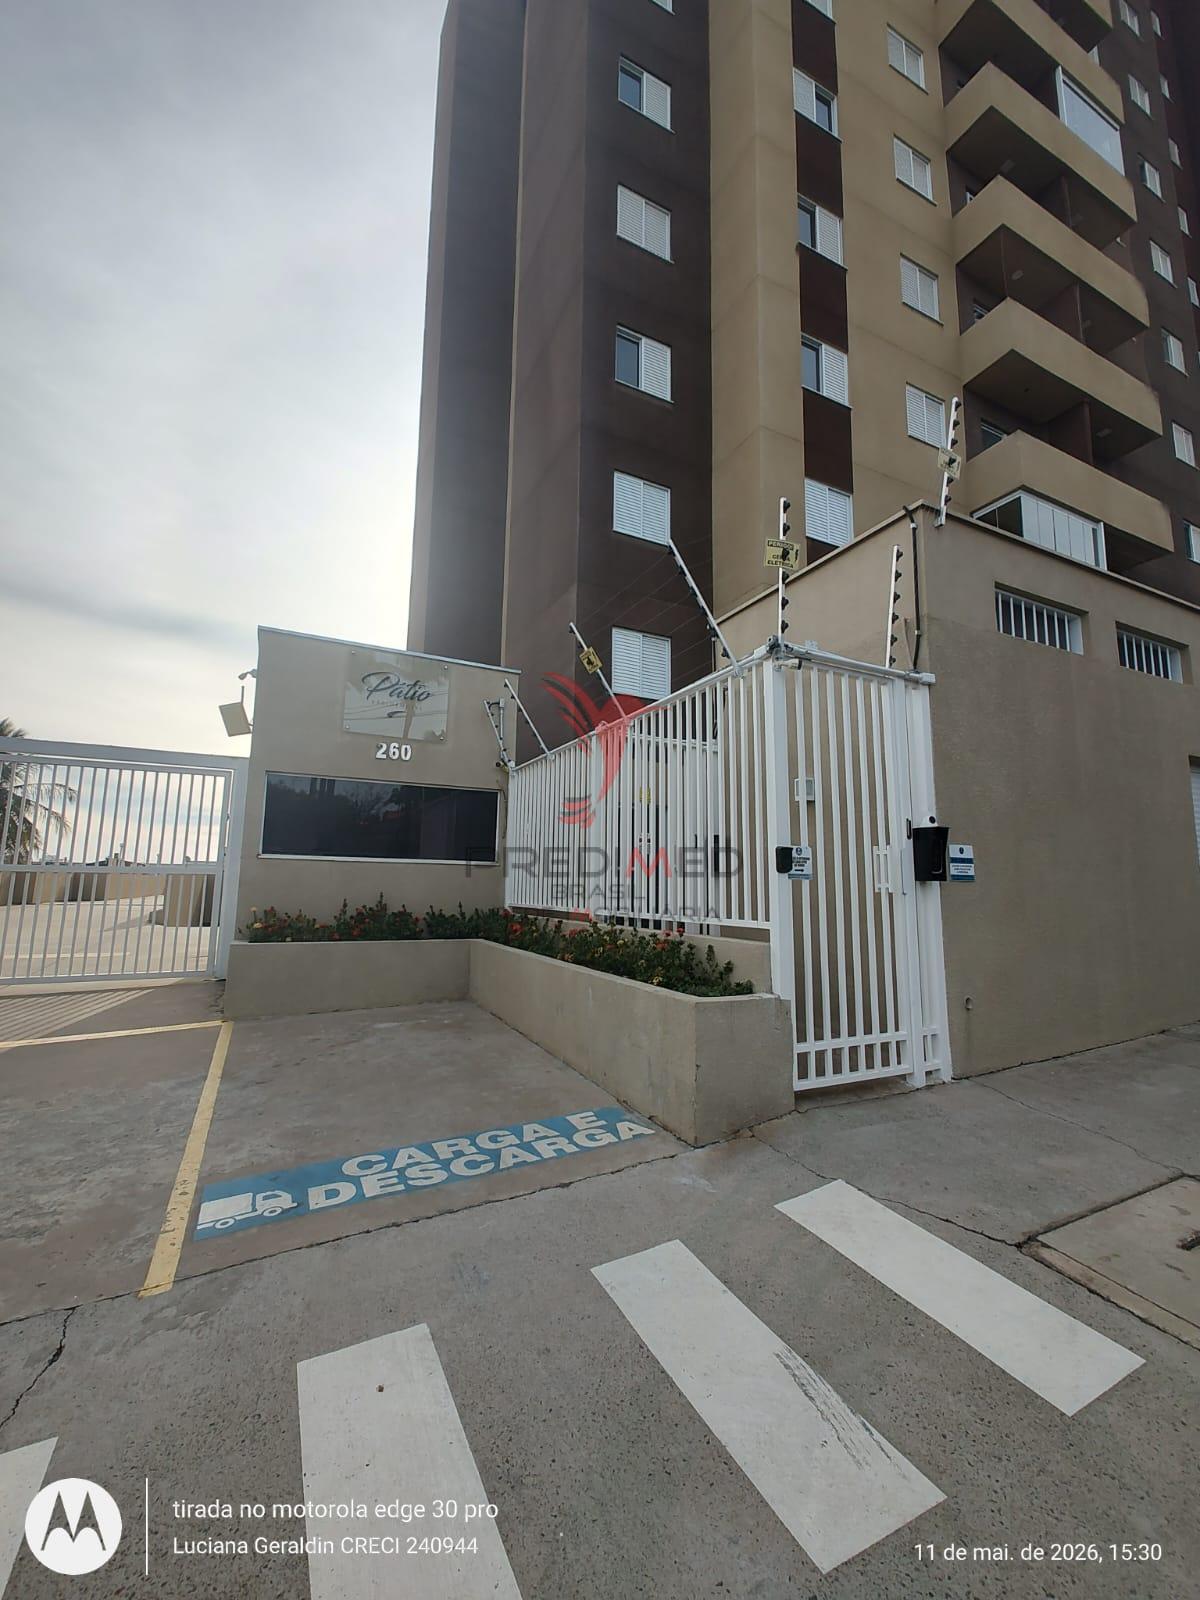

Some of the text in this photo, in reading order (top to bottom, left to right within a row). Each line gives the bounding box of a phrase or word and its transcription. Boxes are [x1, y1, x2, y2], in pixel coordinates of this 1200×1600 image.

[375, 742, 412, 761] 260
[308, 1121, 656, 1210] DESCARGA
[341, 1111, 606, 1177] CARGA E
